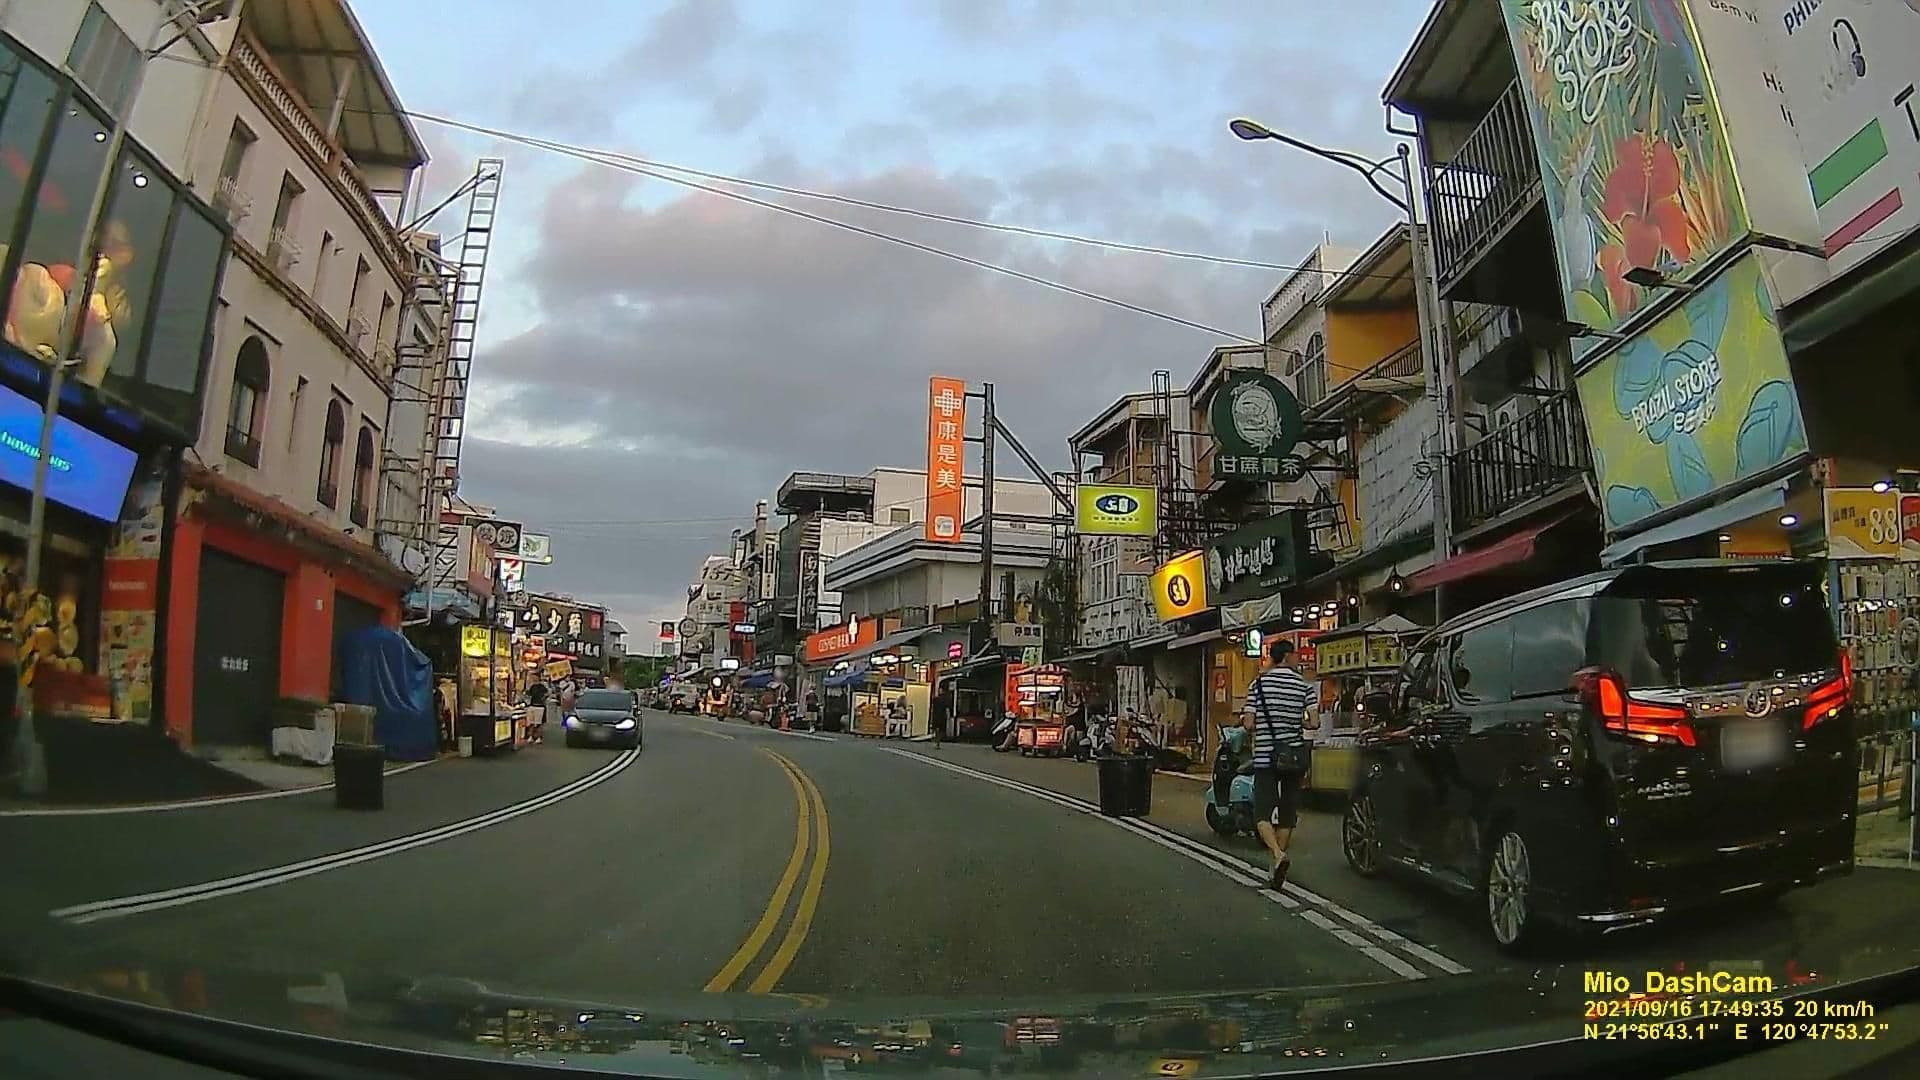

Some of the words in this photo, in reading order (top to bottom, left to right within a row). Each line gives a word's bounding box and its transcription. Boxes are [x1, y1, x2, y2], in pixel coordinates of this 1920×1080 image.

[1632, 384, 1676, 433] BRAZIL
[1675, 354, 1720, 404] STORE
[937, 421, 958, 489] 康是美
[1870, 507, 1899, 544] 88
